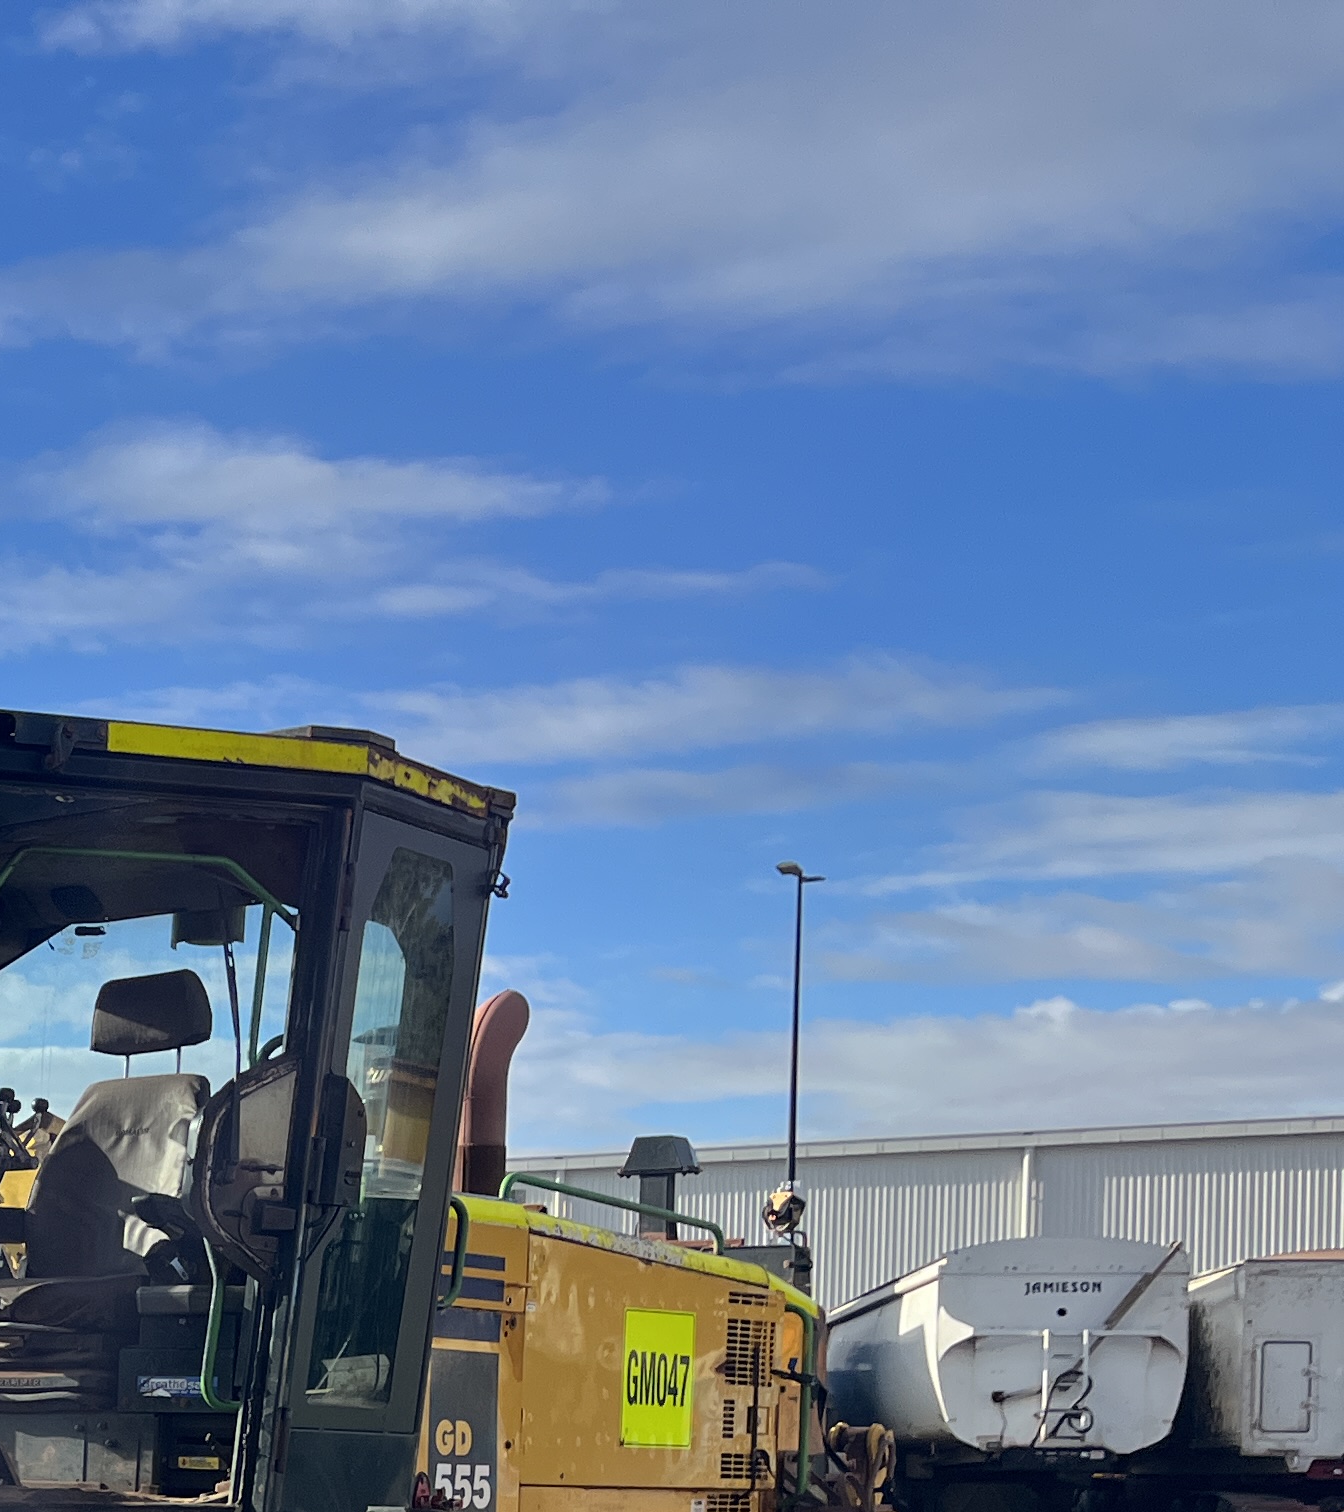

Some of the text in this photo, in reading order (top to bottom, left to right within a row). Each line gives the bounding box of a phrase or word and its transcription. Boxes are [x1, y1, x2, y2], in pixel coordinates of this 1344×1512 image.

[1023, 1280, 1102, 1296] JAMIESON
[627, 1349, 691, 1408] GM047
[435, 1418, 473, 1457] GD
[434, 1462, 492, 1510] 555
